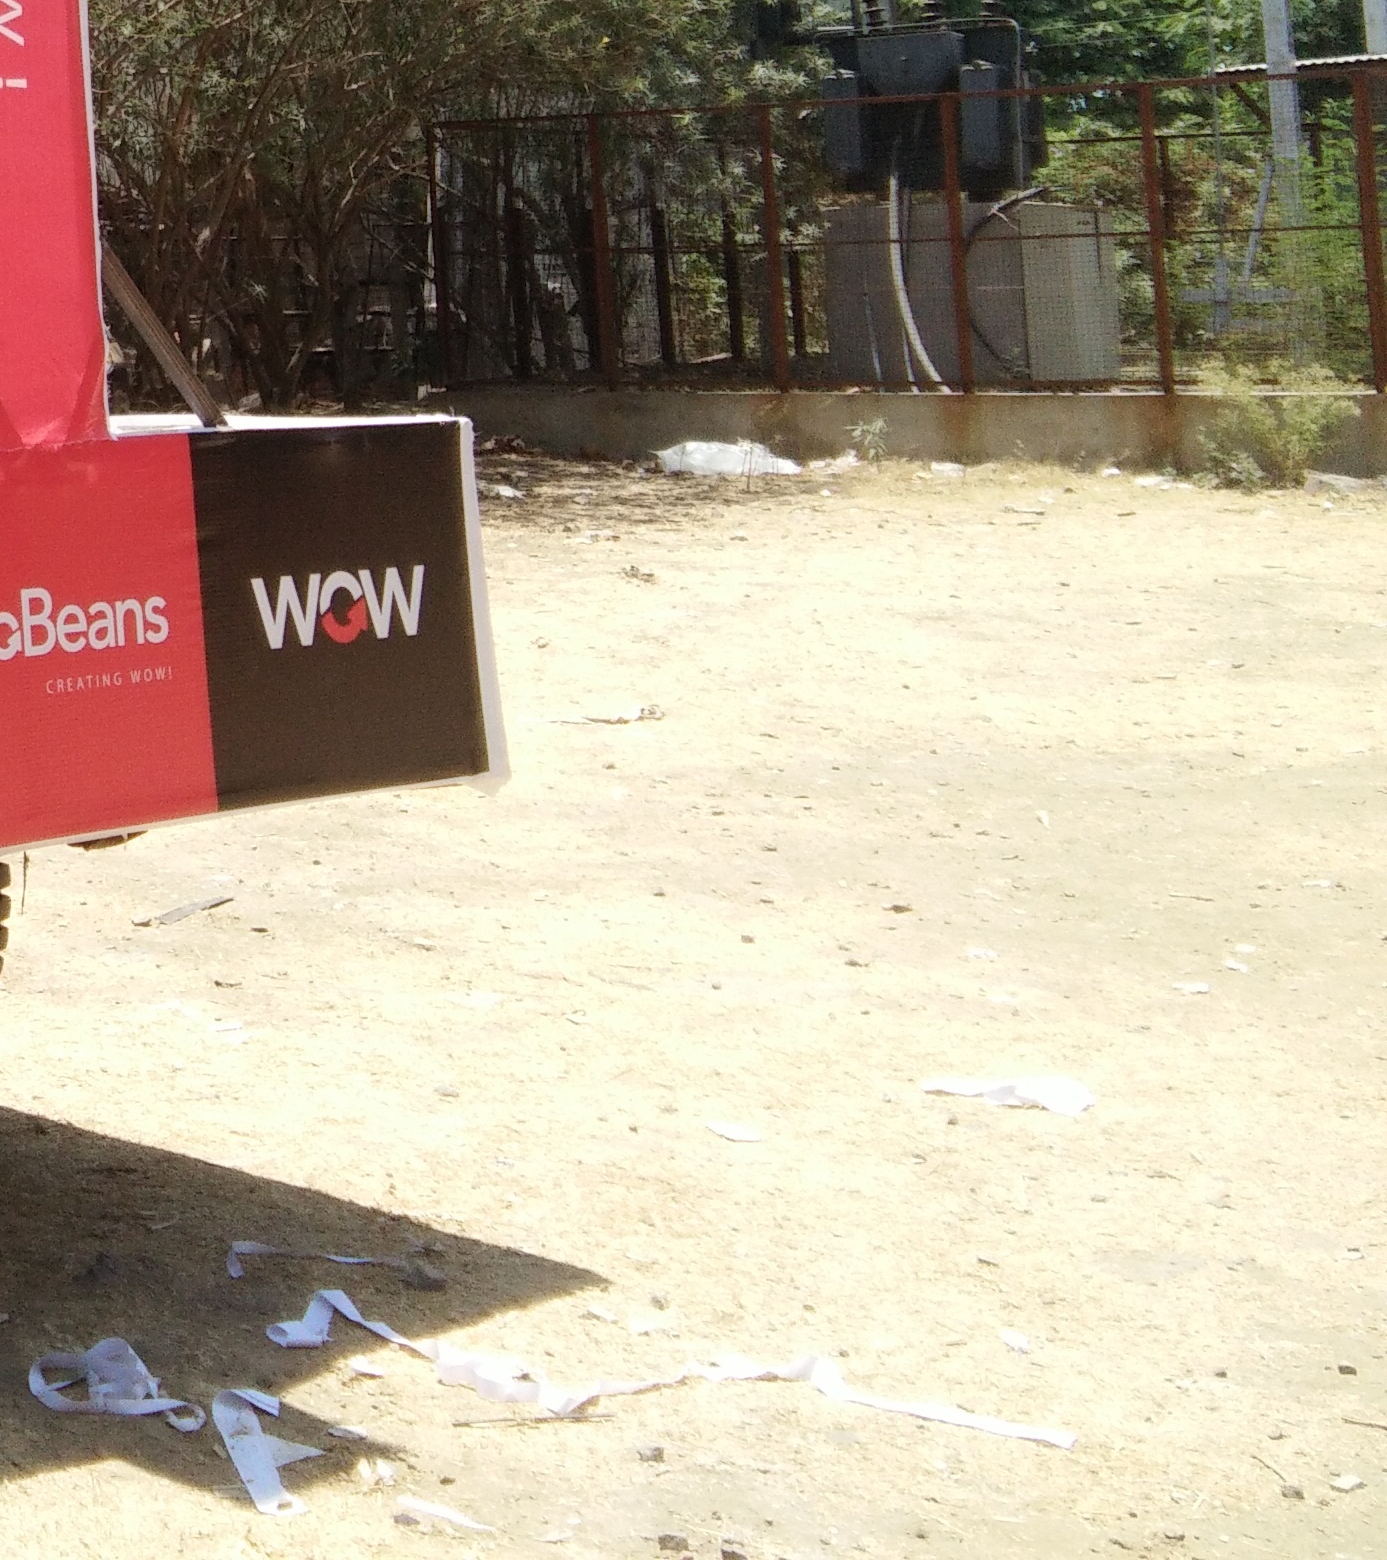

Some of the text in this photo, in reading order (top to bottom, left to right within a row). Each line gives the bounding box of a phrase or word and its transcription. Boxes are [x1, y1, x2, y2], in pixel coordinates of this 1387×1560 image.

[251, 563, 425, 650] WOW
[45, 665, 174, 695] CREATING WOW!
